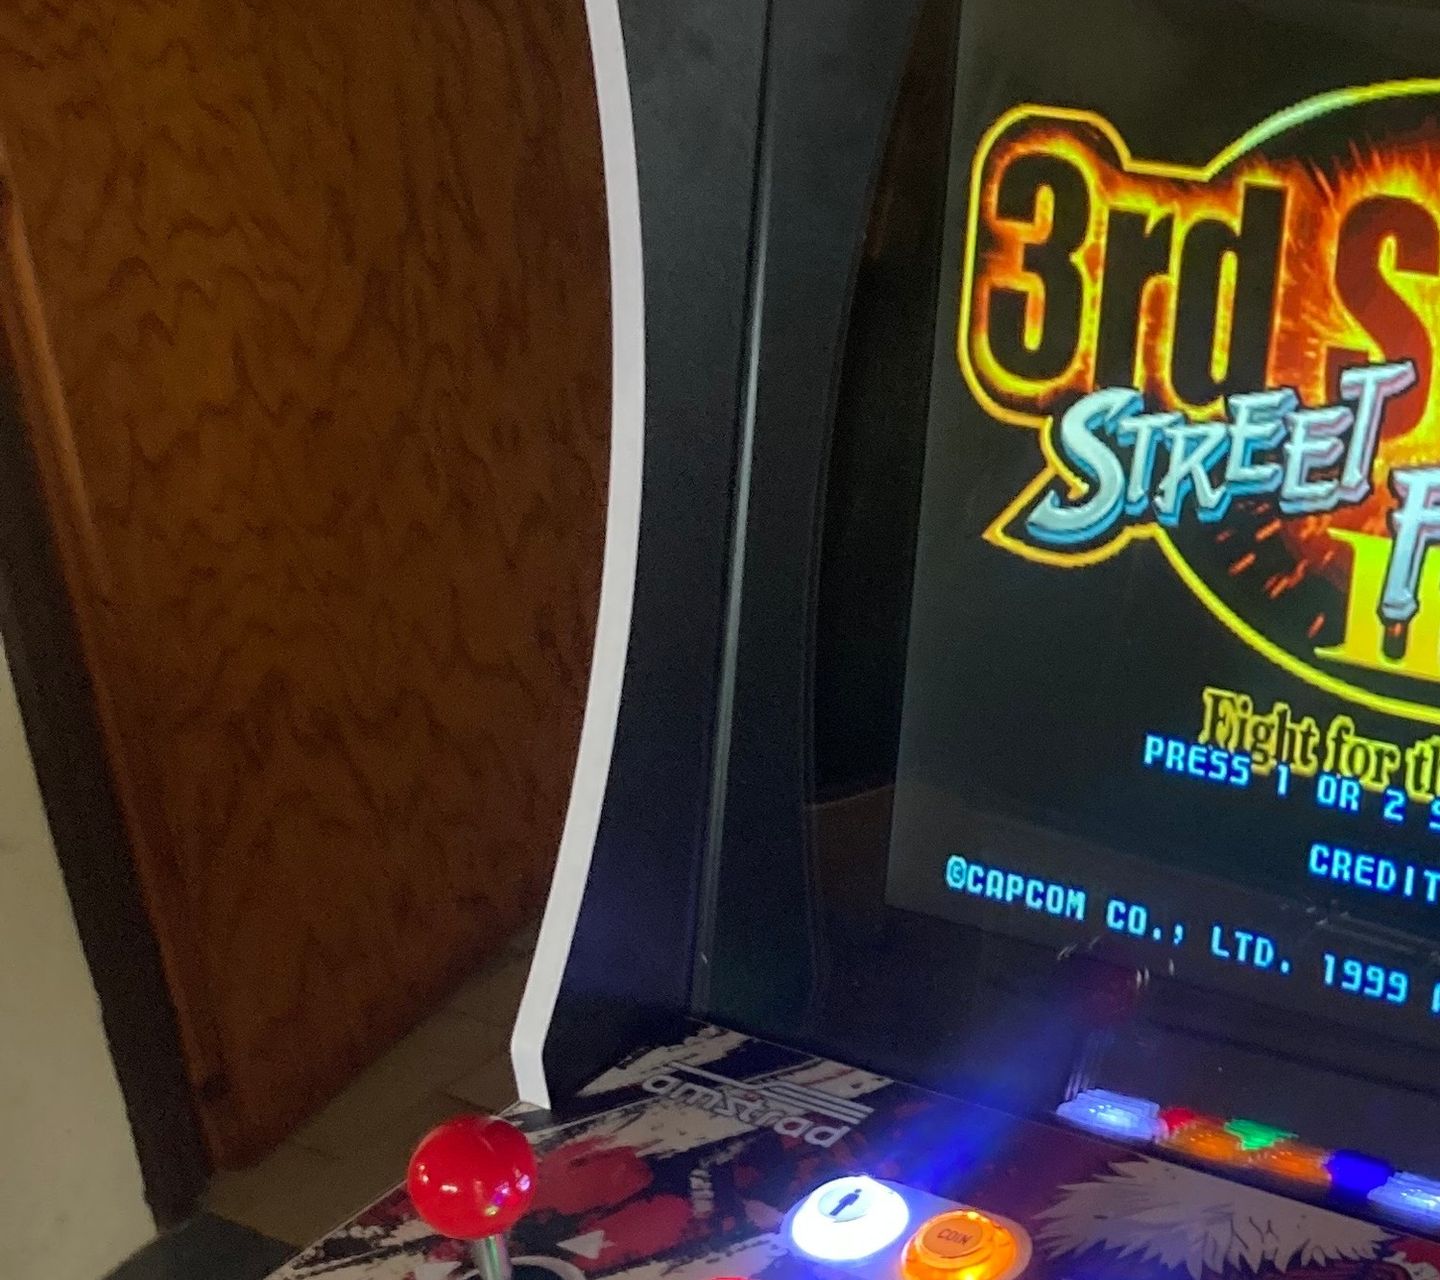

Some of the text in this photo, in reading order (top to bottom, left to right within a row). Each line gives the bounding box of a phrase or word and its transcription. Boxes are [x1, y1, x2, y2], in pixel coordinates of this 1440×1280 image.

[986, 150, 1290, 410] 3rd
[1024, 360, 1416, 550] STREET
[1143, 733, 1251, 787] PRESS
[1274, 763, 1292, 797] 1
[1317, 776, 1361, 813] OR
[1381, 788, 1406, 823] 2
[1198, 687, 1320, 776] Fight
[1322, 717, 1402, 790] for
[1105, 898, 1186, 947] CO.,
[1209, 925, 1293, 975] LTD.
[1321, 952, 1410, 1005] 1999
[641, 1074, 852, 1149] amstrad
[937, 1228, 973, 1248] COIN
